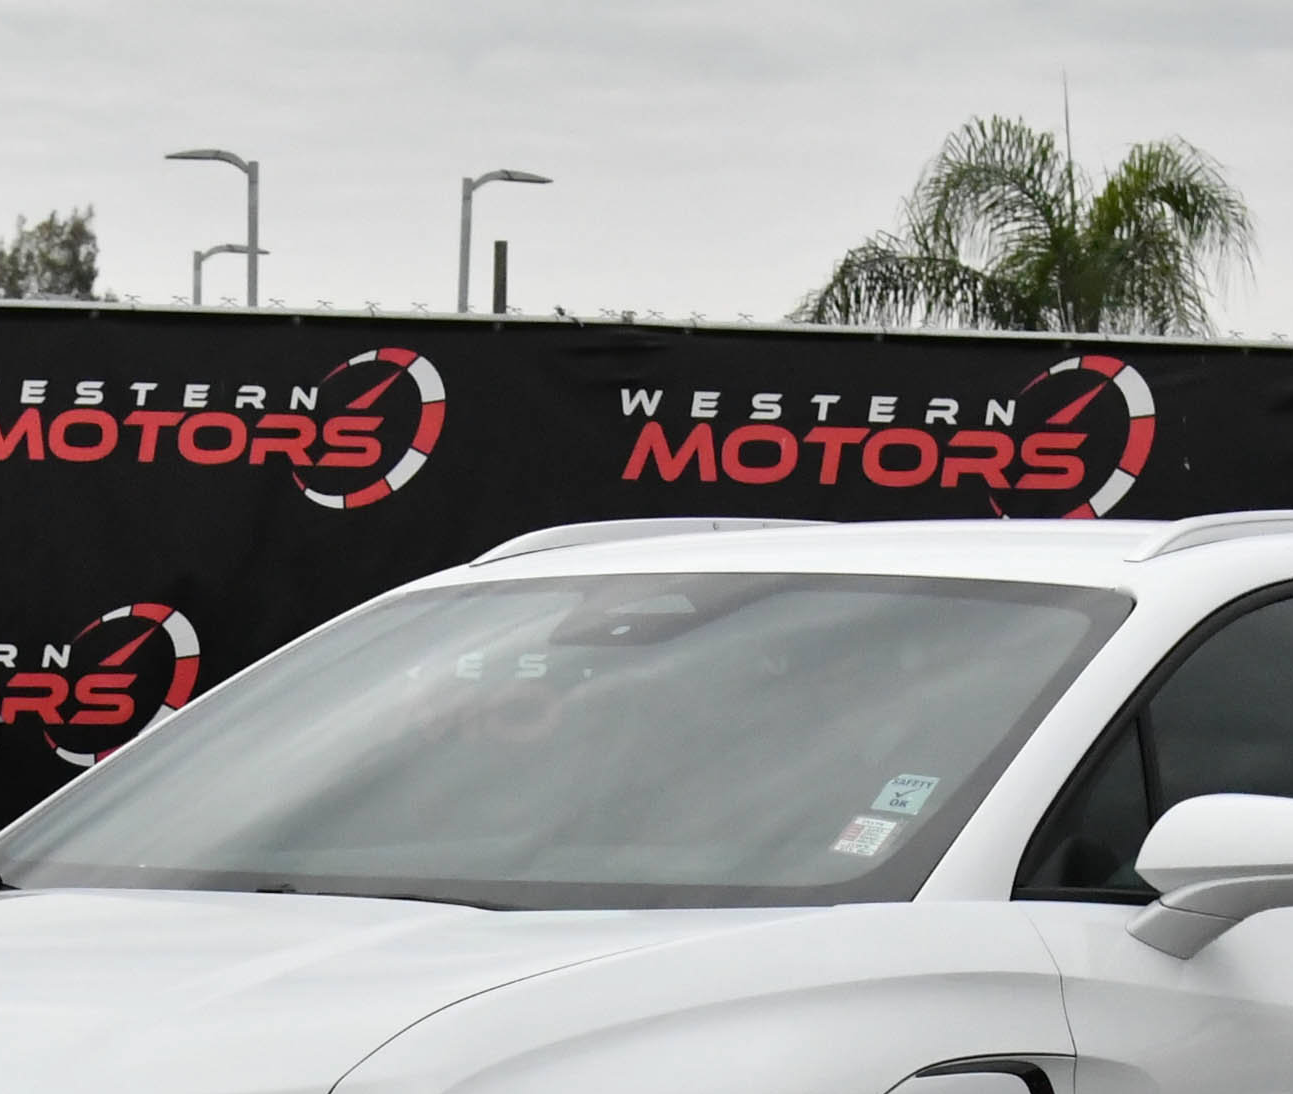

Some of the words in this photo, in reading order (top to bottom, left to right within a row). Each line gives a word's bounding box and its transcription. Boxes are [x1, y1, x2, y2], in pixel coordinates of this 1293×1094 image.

[621, 389, 1015, 426] WESTERN
[623, 422, 1087, 489] MOTORS
[889, 799, 908, 808] OK
